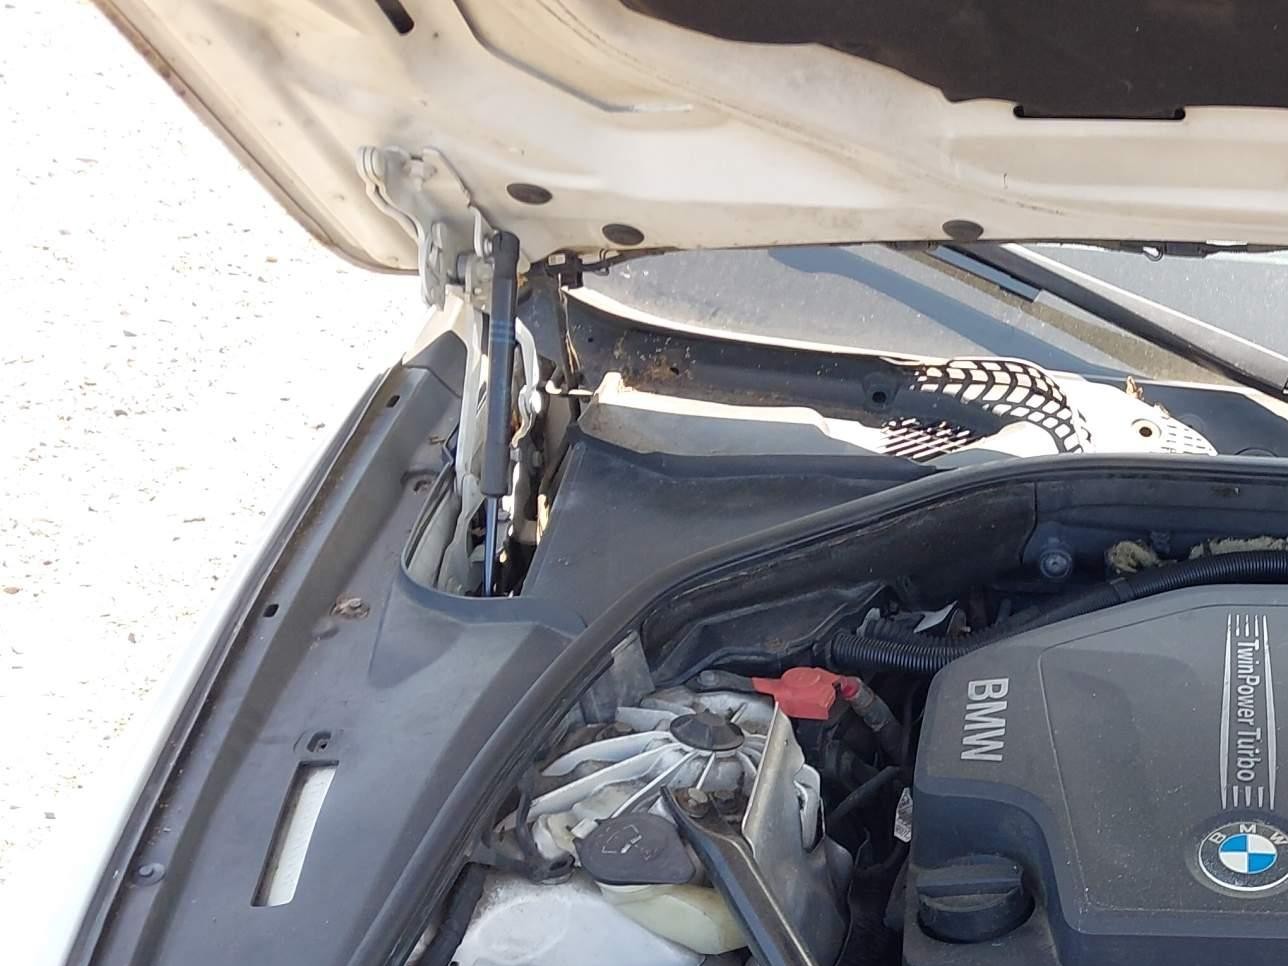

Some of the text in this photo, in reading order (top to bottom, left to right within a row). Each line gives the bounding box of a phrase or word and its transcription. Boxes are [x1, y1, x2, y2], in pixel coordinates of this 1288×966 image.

[960, 677, 1010, 763] BMW
[1237, 638, 1262, 782] TwinPower Turbo
